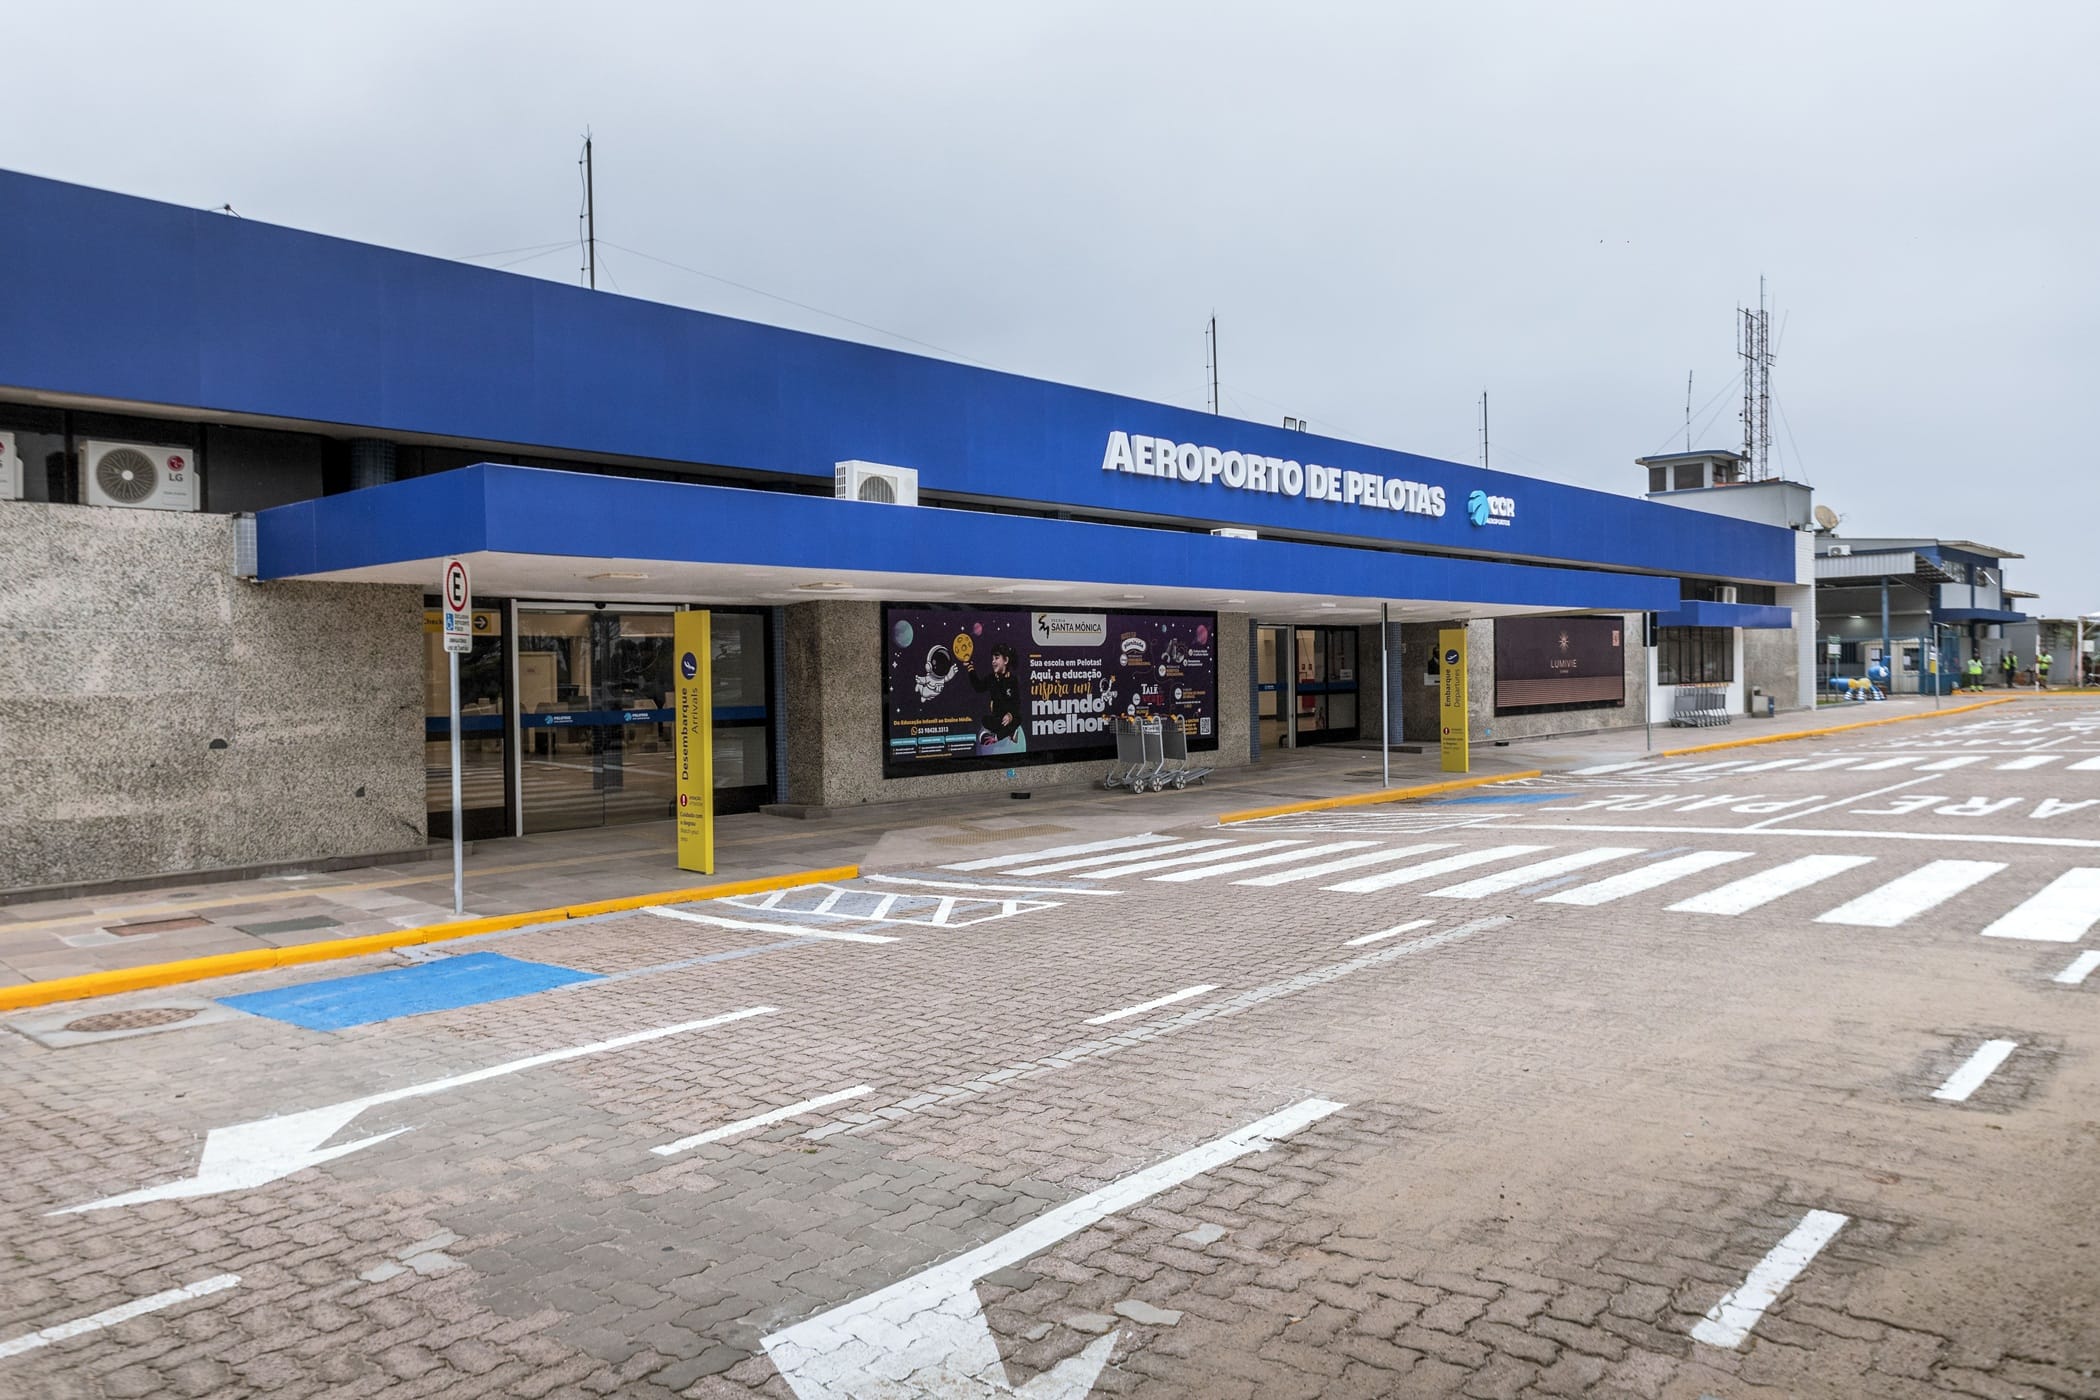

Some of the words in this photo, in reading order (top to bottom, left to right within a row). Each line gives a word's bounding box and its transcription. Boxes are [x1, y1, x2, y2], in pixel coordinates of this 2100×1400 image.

[169, 473, 183, 481] LG
[1103, 431, 1303, 496] AEROPORTO
[1305, 464, 1342, 503] DE
[1343, 470, 1446, 517] PELOTAS
[1487, 496, 1515, 517] CCR
[453, 571, 461, 602] E
[1051, 622, 1073, 632] SANTA
[1075, 621, 1102, 632] MÔNICA
[1030, 659, 1043, 667] Sua
[1044, 659, 1065, 667] escola
[1077, 658, 1102, 667] Pelotas!
[1030, 668, 1054, 682] Aqui,
[1055, 671, 1060, 679] a
[1062, 668, 1102, 682] educação
[1031, 679, 1069, 700] inspira
[1073, 681, 1092, 694] um
[1032, 694, 1105, 715] mundo
[681, 687, 689, 780] Desembarque
[1032, 713, 1106, 735] melhor
[1538, 794, 1829, 812] PARE
[1848, 795, 2100, 819] ARE
